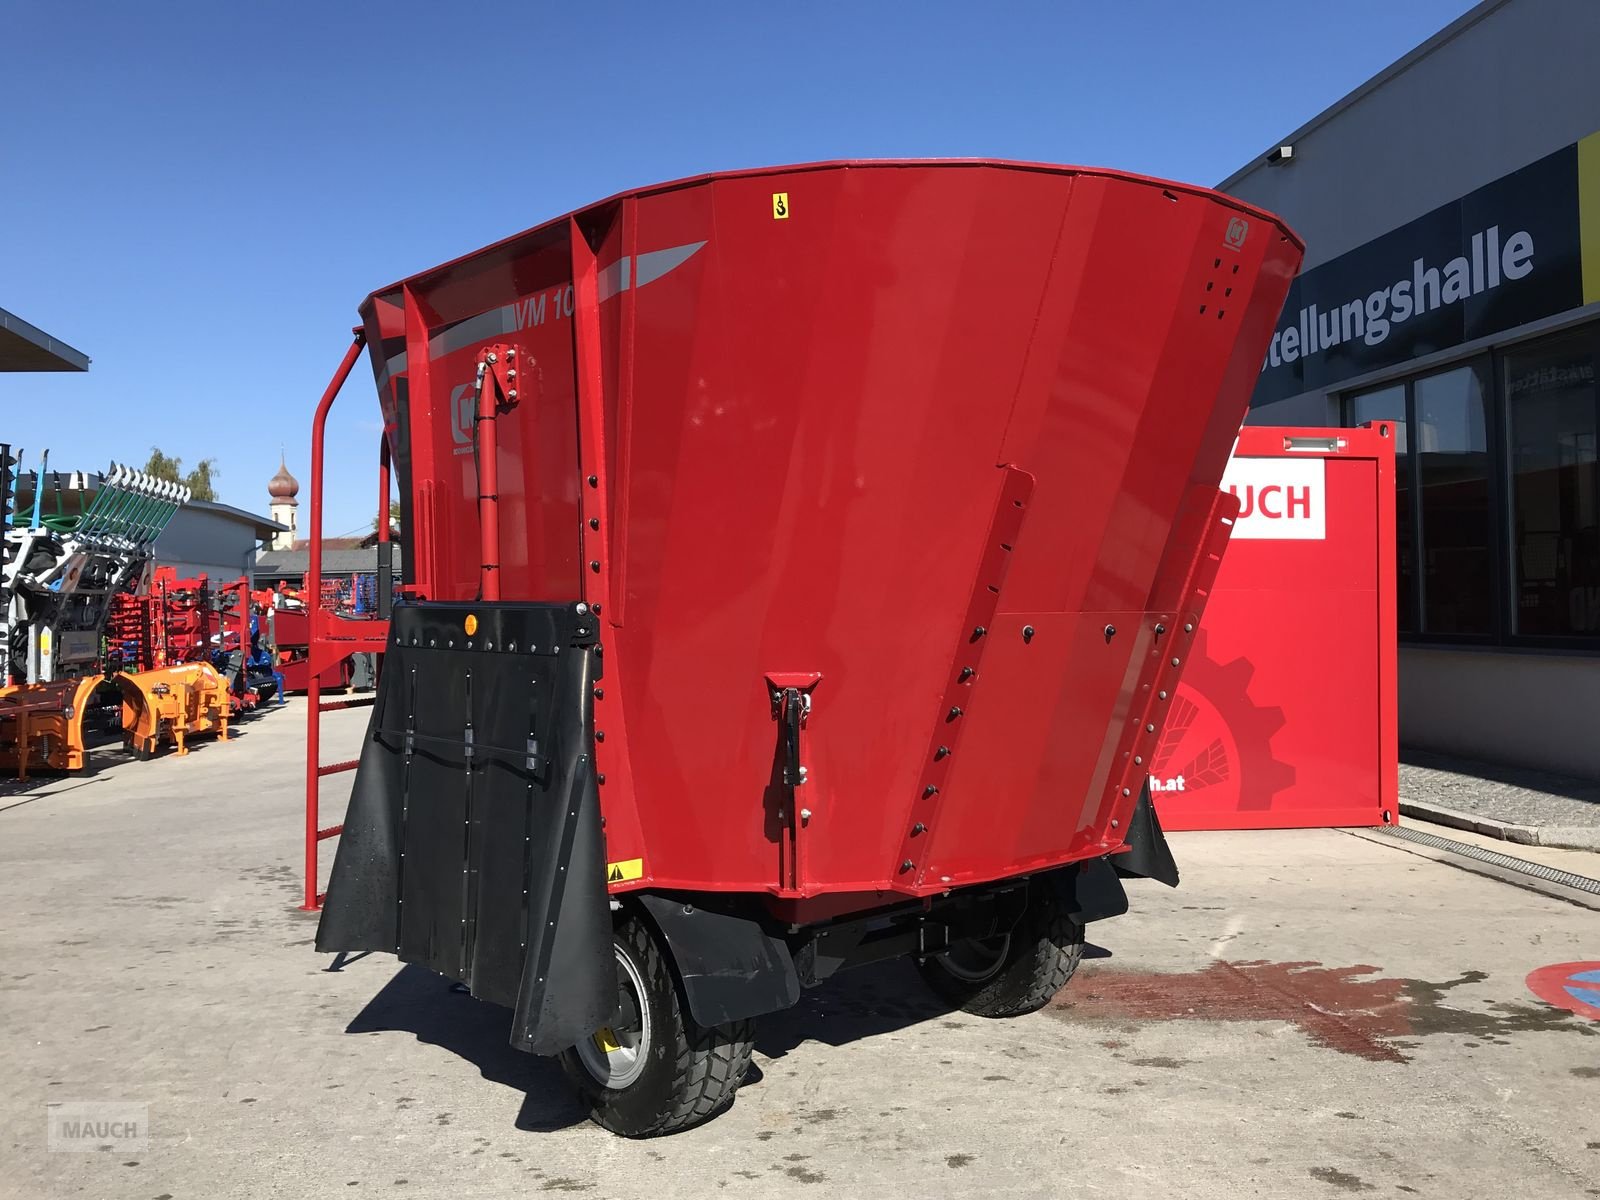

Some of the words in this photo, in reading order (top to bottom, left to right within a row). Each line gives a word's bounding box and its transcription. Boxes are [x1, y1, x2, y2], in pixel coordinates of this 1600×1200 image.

[515, 292, 547, 331] VM
[553, 284, 575, 320] 10
[1262, 224, 1534, 373] tellungshalle
[1229, 484, 1311, 519] UCH
[1149, 775, 1185, 791] h.at
